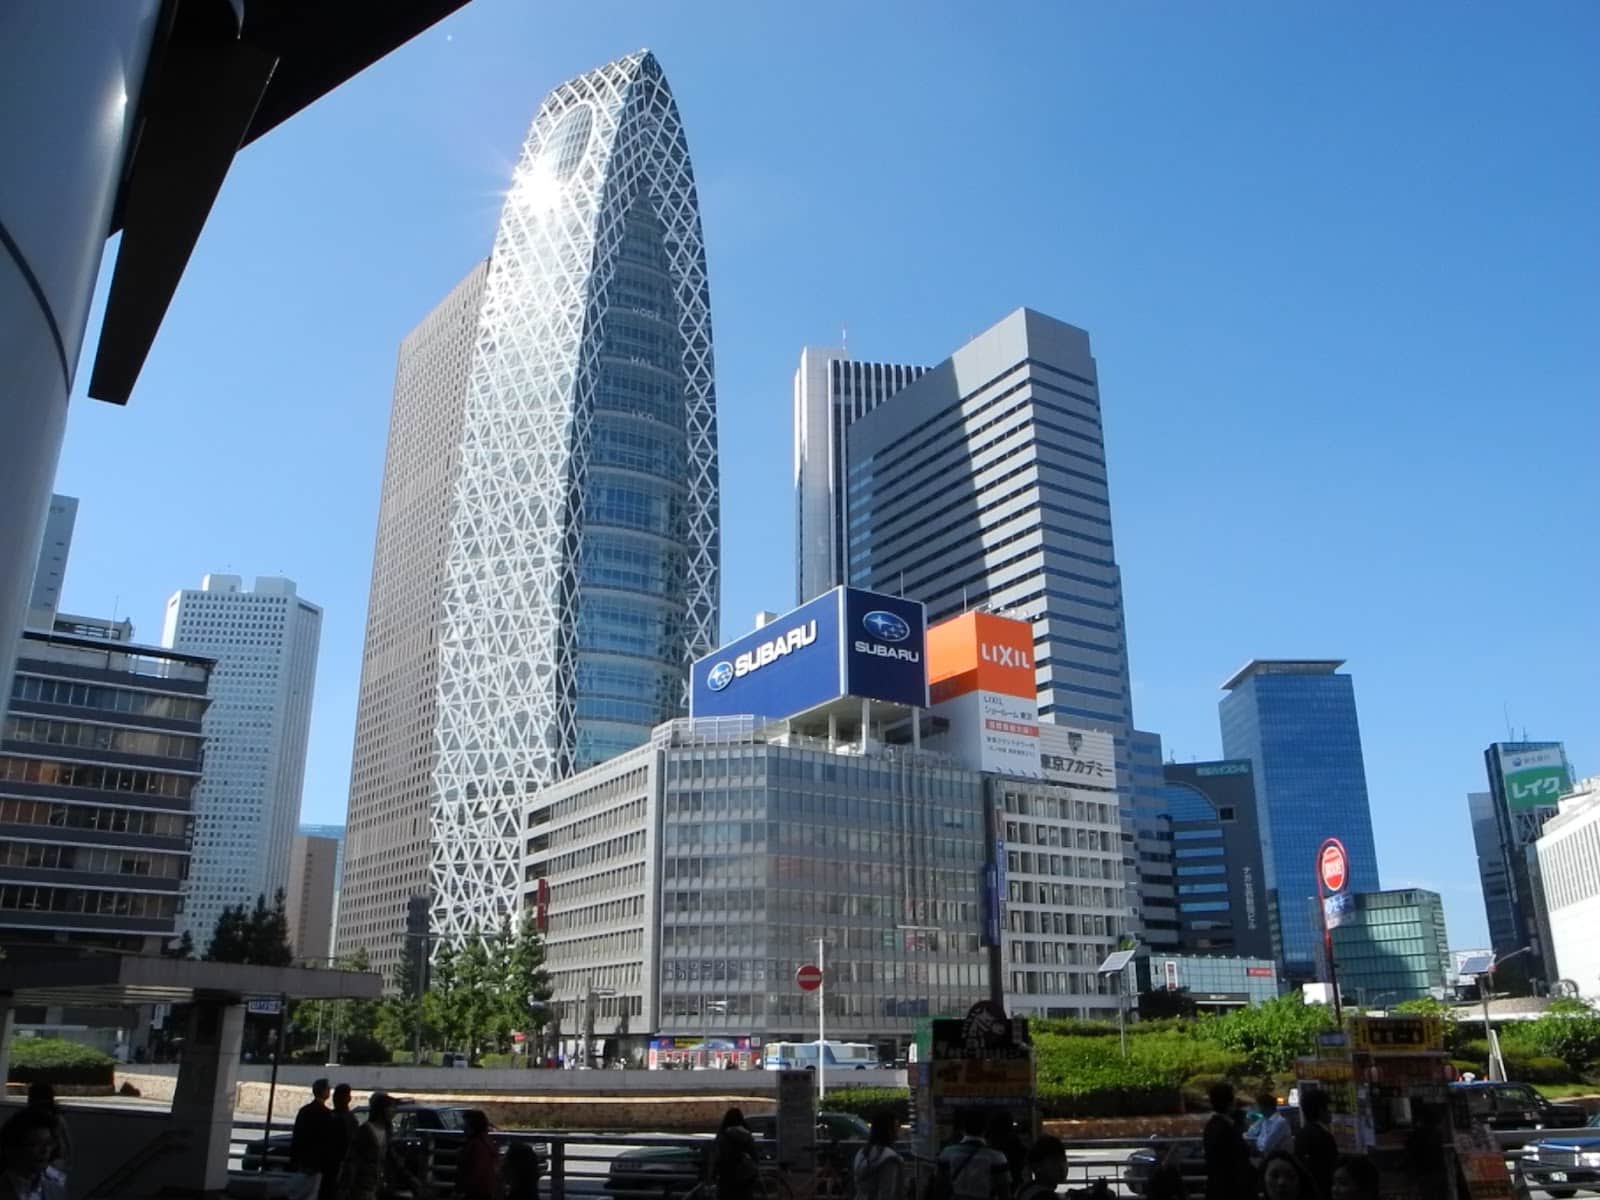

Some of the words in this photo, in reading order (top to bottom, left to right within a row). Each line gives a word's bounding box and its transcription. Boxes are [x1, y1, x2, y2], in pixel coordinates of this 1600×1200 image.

[735, 620, 818, 677] SUBARU
[854, 640, 920, 663] SUBARU
[981, 643, 1031, 669] LIXIL
[1511, 775, 1560, 800] レイク
